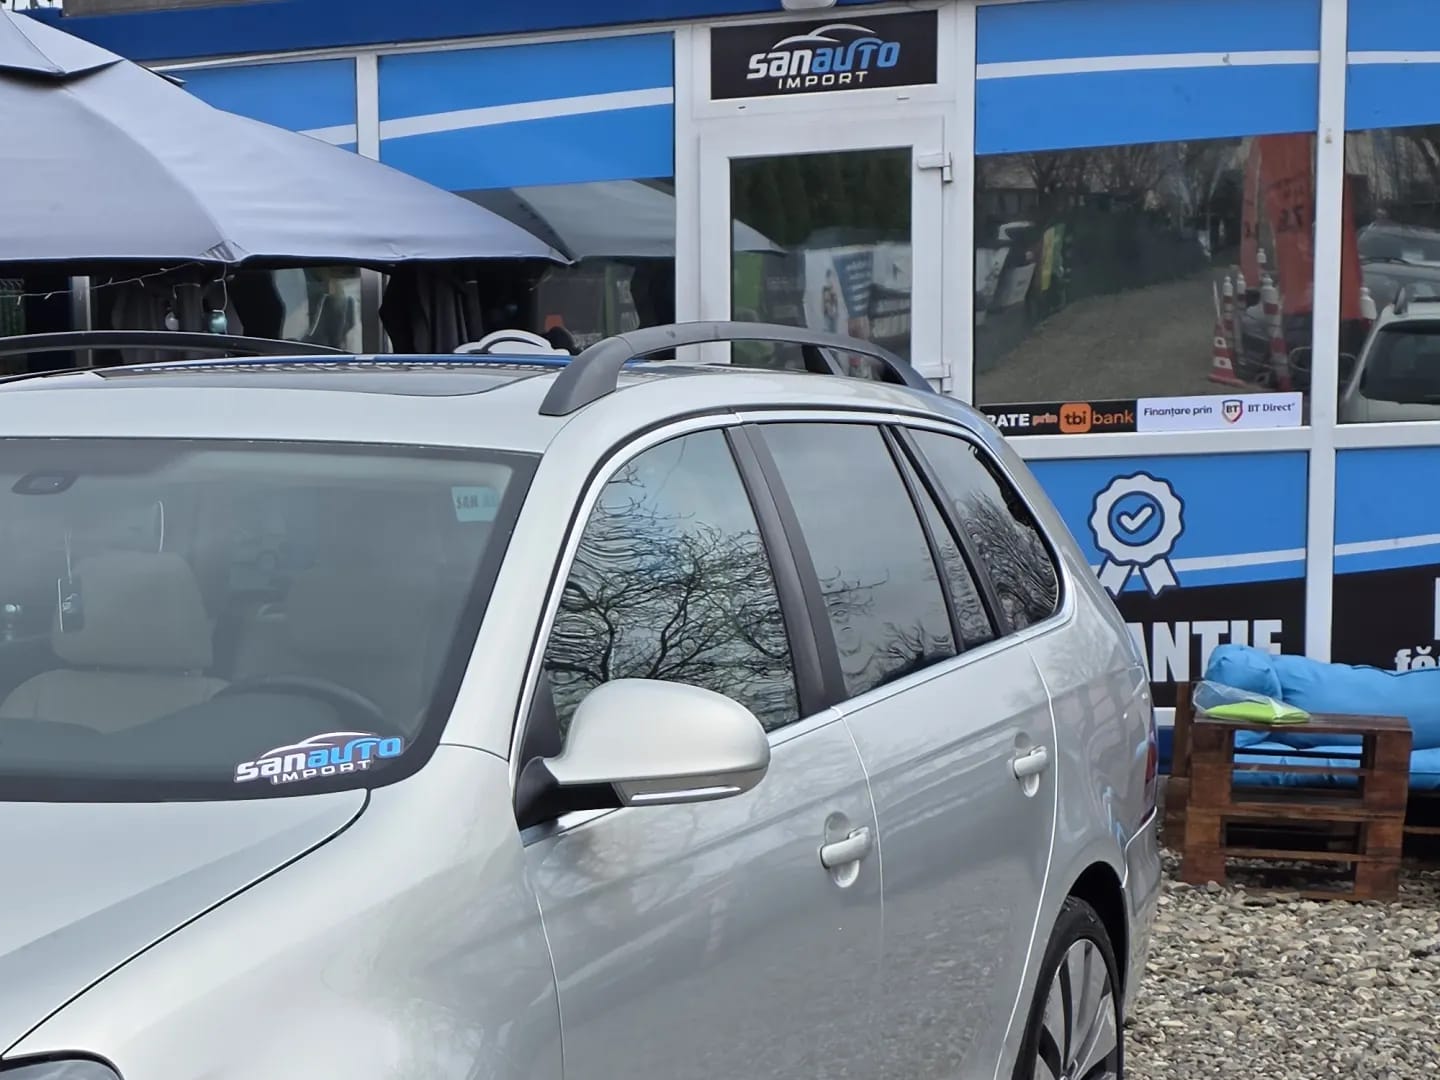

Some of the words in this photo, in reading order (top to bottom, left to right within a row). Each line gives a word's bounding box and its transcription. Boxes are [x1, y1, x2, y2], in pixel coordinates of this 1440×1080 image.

[777, 70, 869, 90] IMPORT
[1193, 405, 1213, 417] prin
[1226, 404, 1240, 414] BT
[1247, 403, 1260, 413] BT
[1064, 411, 1088, 426] tbi
[1092, 409, 1135, 426] bank
[272, 759, 372, 784] IMPORT
